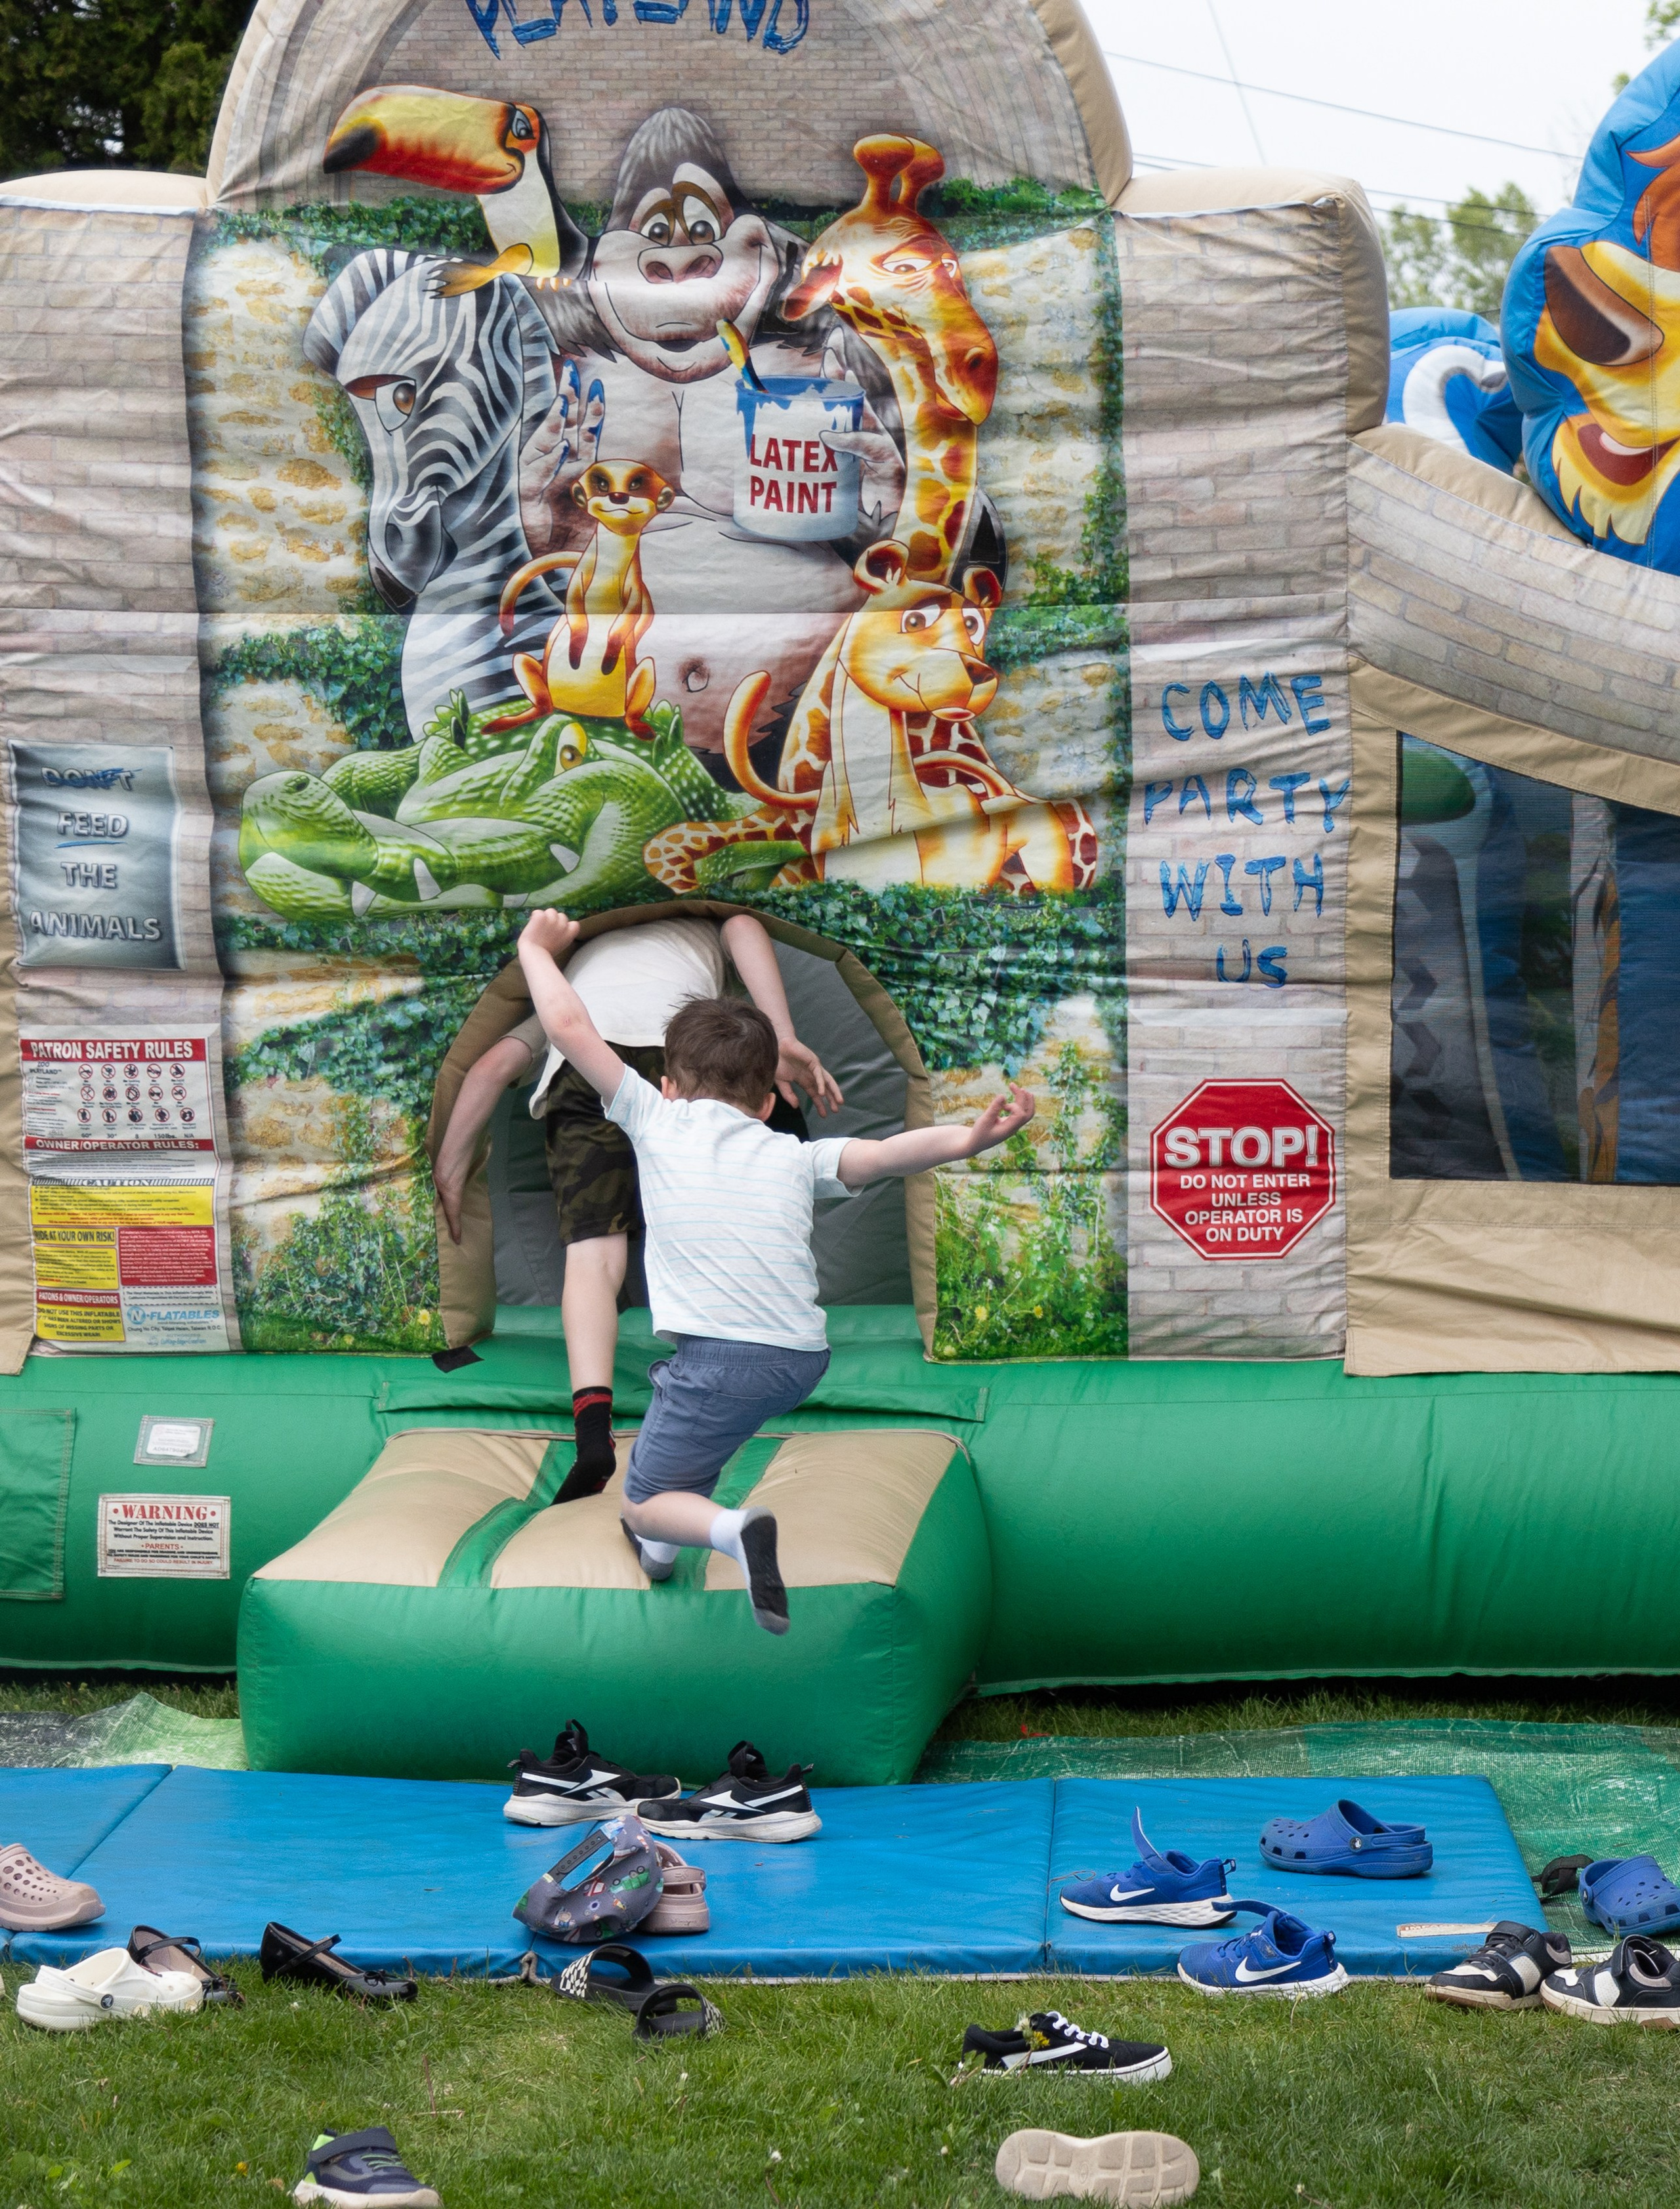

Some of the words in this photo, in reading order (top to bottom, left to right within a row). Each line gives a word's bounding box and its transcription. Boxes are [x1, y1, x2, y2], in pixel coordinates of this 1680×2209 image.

[749, 434, 838, 473] LATEX
[750, 475, 837, 513] PAINT
[1161, 670, 1330, 741] COME
[1144, 768, 1349, 833] PARTY
[57, 811, 129, 837] FEED
[61, 862, 117, 889] THE
[1159, 853, 1324, 921] WITH
[30, 910, 161, 941] ANIMALS
[1216, 937, 1288, 988] US
[30, 1041, 82, 1059] PATRON
[86, 1042, 140, 1059] SAFETY
[144, 1041, 193, 1059] RULES
[36, 1139, 150, 1150] OWNER/OPERATOR
[154, 1141, 199, 1149] RULES:
[1164, 1125, 1318, 1168] STOP!
[1180, 1175, 1206, 1189] DO
[1211, 1174, 1247, 1189] NOT
[1253, 1173, 1311, 1188] ENTER
[1211, 1192, 1282, 1208] UNLESS
[1185, 1209, 1281, 1225] OPERATOR
[1287, 1208, 1303, 1223] IS
[49, 1231, 56, 1240] AT
[57, 1231, 76, 1241] YOUR
[78, 1231, 94, 1242] OWN
[96, 1231, 115, 1242] RISK!
[1206, 1227, 1231, 1242] ON
[1236, 1227, 1284, 1241] DUTY
[122, 1504, 207, 1521] WARNING
